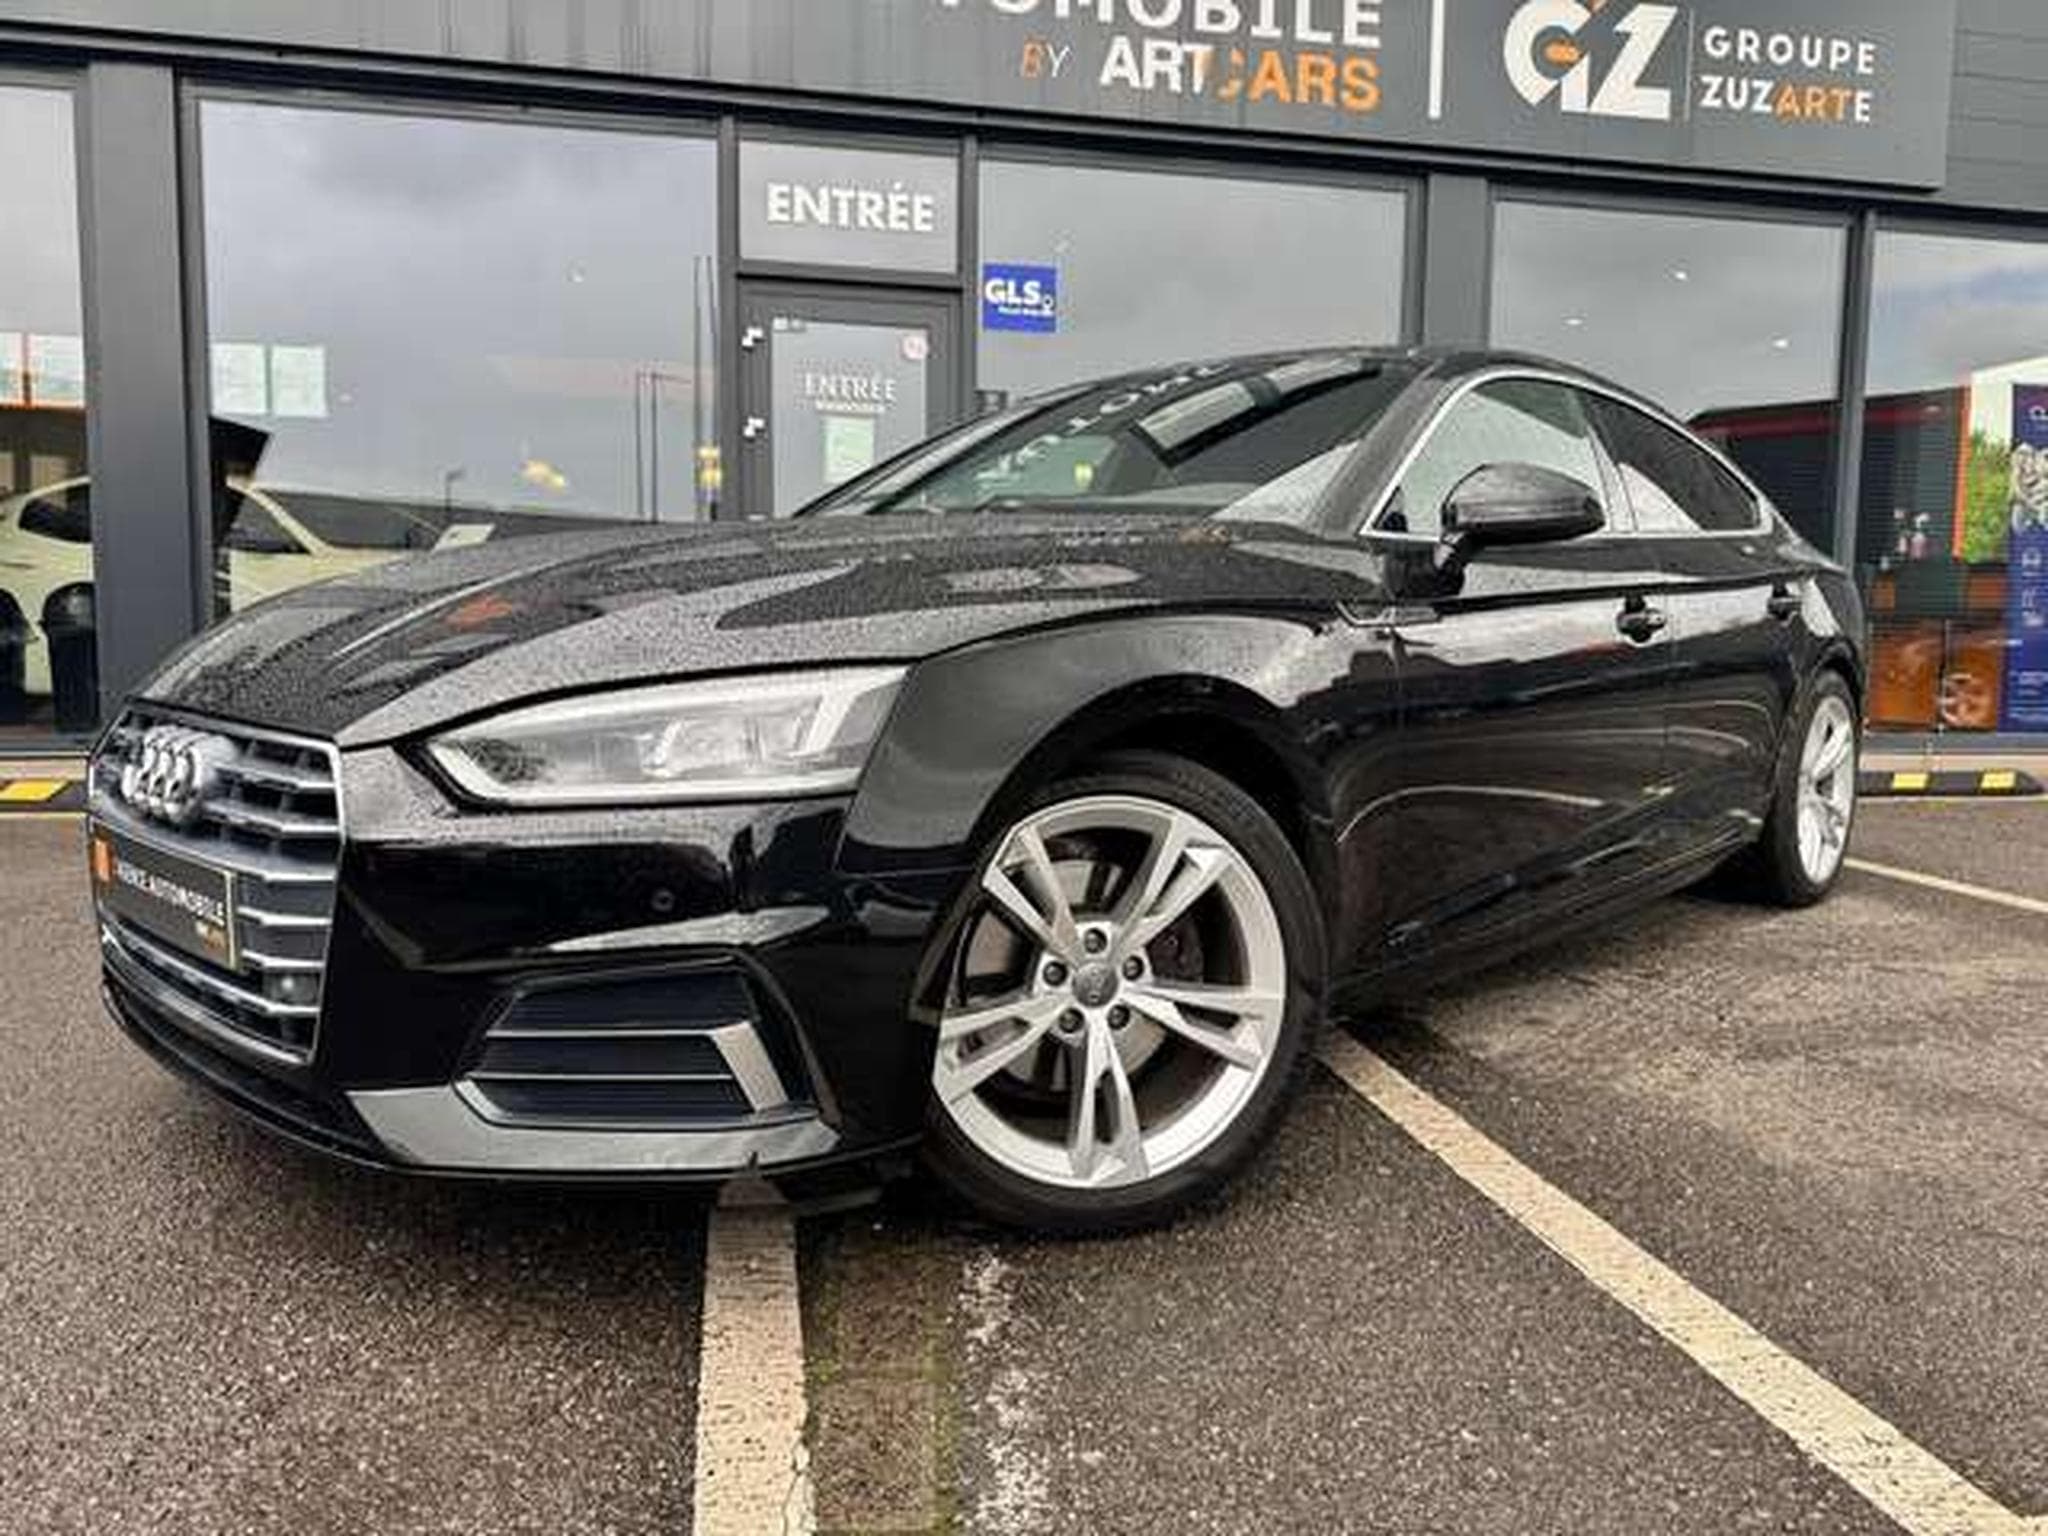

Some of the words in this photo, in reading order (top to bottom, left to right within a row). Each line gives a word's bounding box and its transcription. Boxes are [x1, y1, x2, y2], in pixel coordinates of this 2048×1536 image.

[941, 0, 1382, 49] OBILE
[1021, 37, 1071, 78] BY
[1704, 27, 1876, 75] GROUPE
[1701, 76, 1872, 124] ZUZARTE
[766, 181, 934, 233] ENTRÉE
[985, 277, 1042, 305] GLS
[804, 371, 897, 402] ENTRÉE
